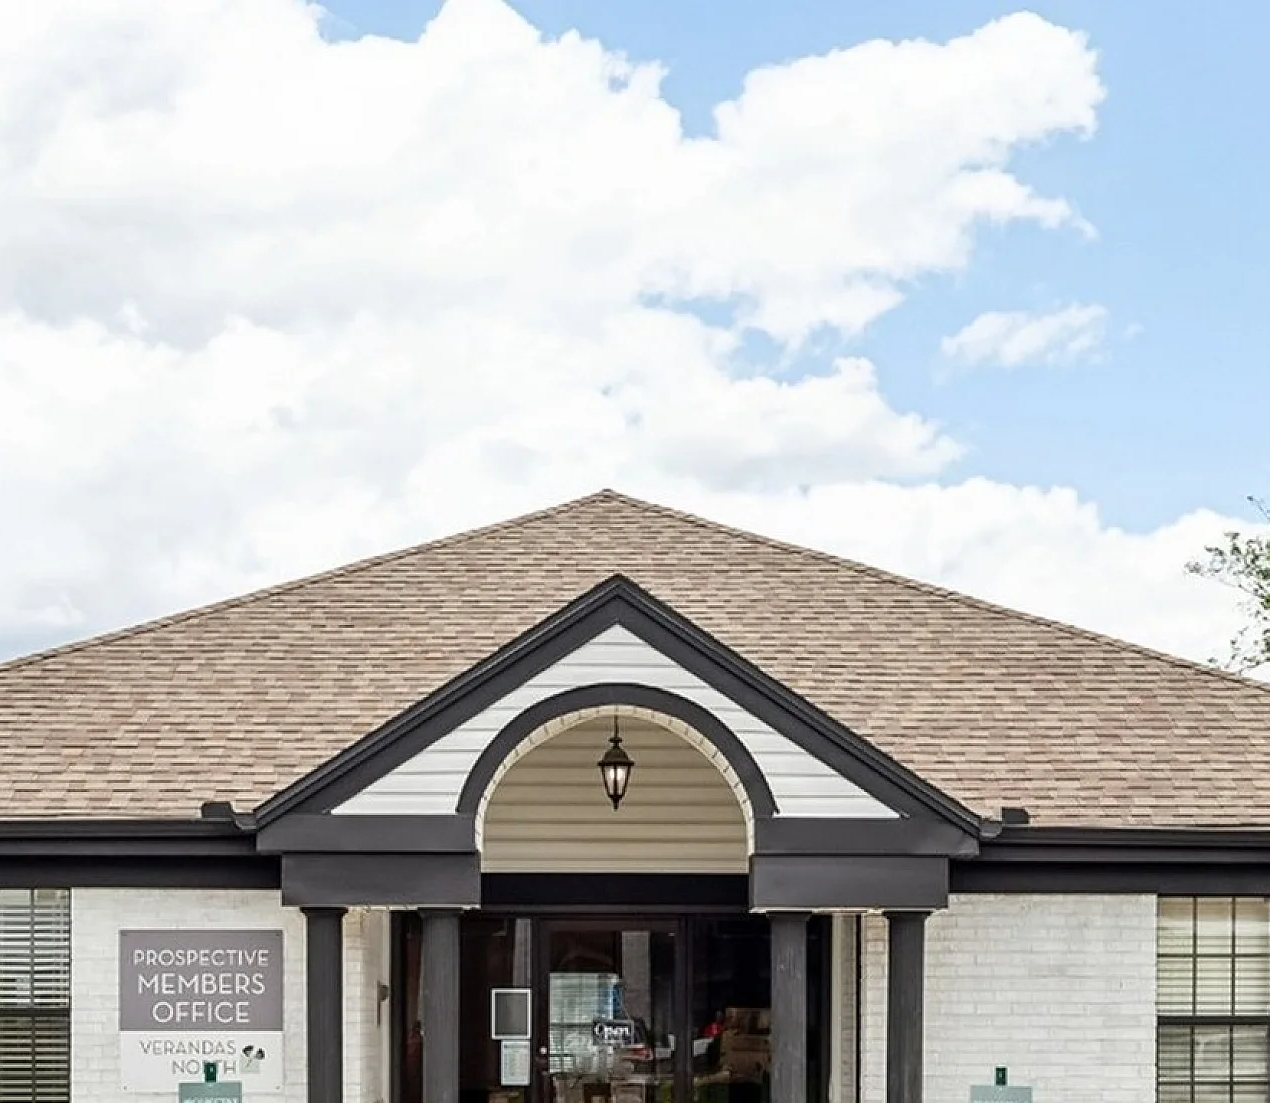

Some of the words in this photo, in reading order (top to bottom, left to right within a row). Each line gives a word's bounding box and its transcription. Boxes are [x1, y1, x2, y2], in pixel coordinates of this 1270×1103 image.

[133, 949, 270, 967] PROSPECTIVE
[137, 973, 266, 995] MEMBERS
[152, 1001, 251, 1023] OFFICE
[139, 1040, 237, 1055] VERANDAS
[172, 1059, 237, 1075] NOH
